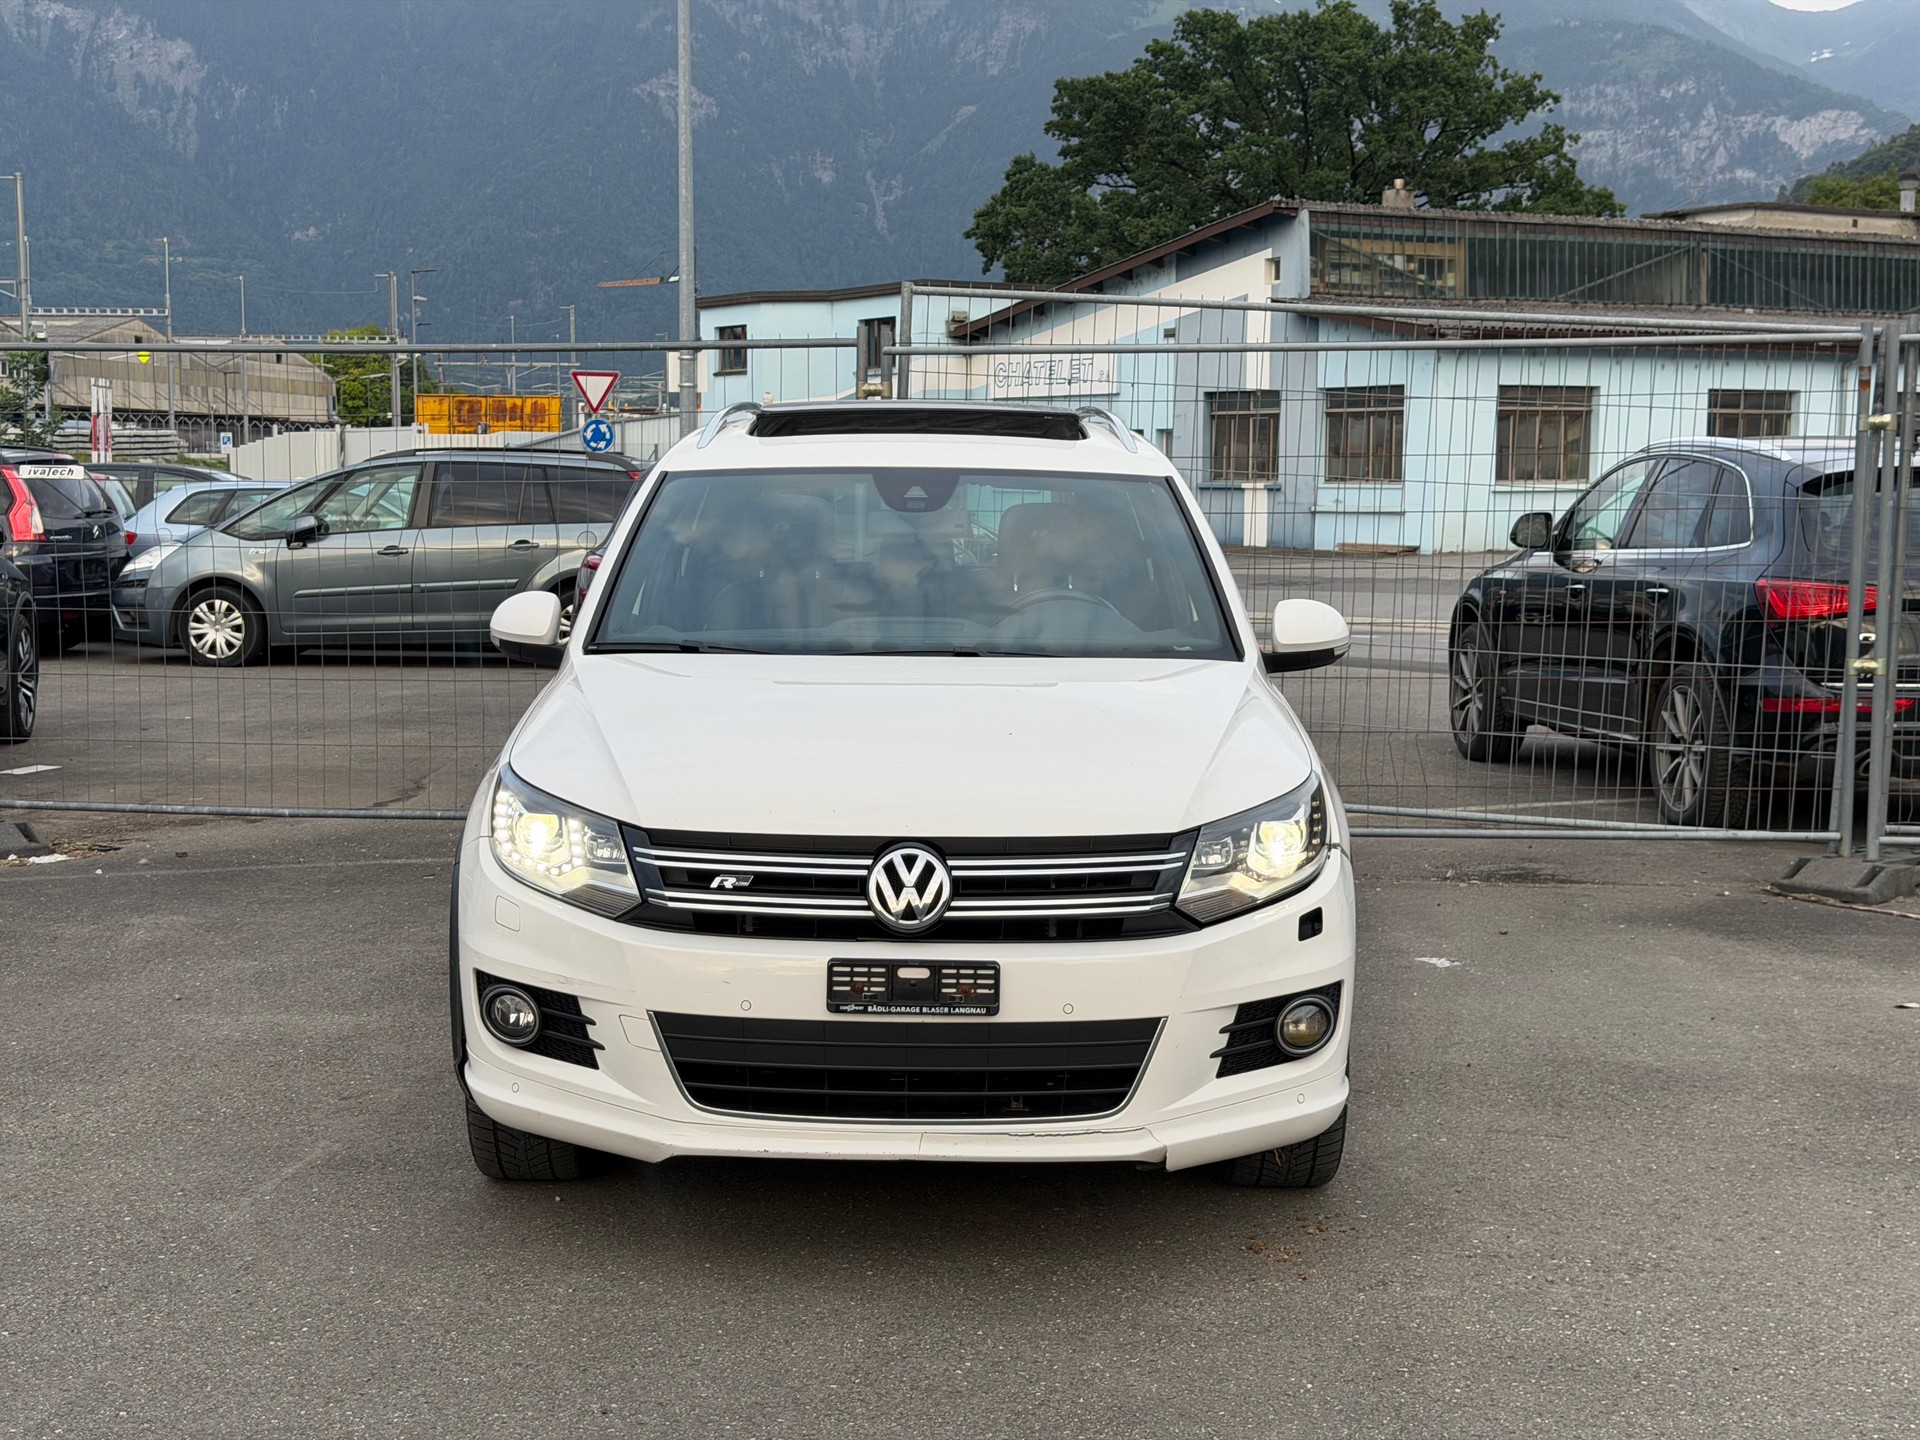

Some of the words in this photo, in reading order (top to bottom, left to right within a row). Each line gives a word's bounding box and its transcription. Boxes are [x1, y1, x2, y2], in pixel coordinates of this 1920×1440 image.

[995, 358, 1093, 388] CHATELET
[875, 852, 944, 922] VW
[922, 1006, 949, 1014] BLASER
[950, 1006, 987, 1014] LANGNAU
